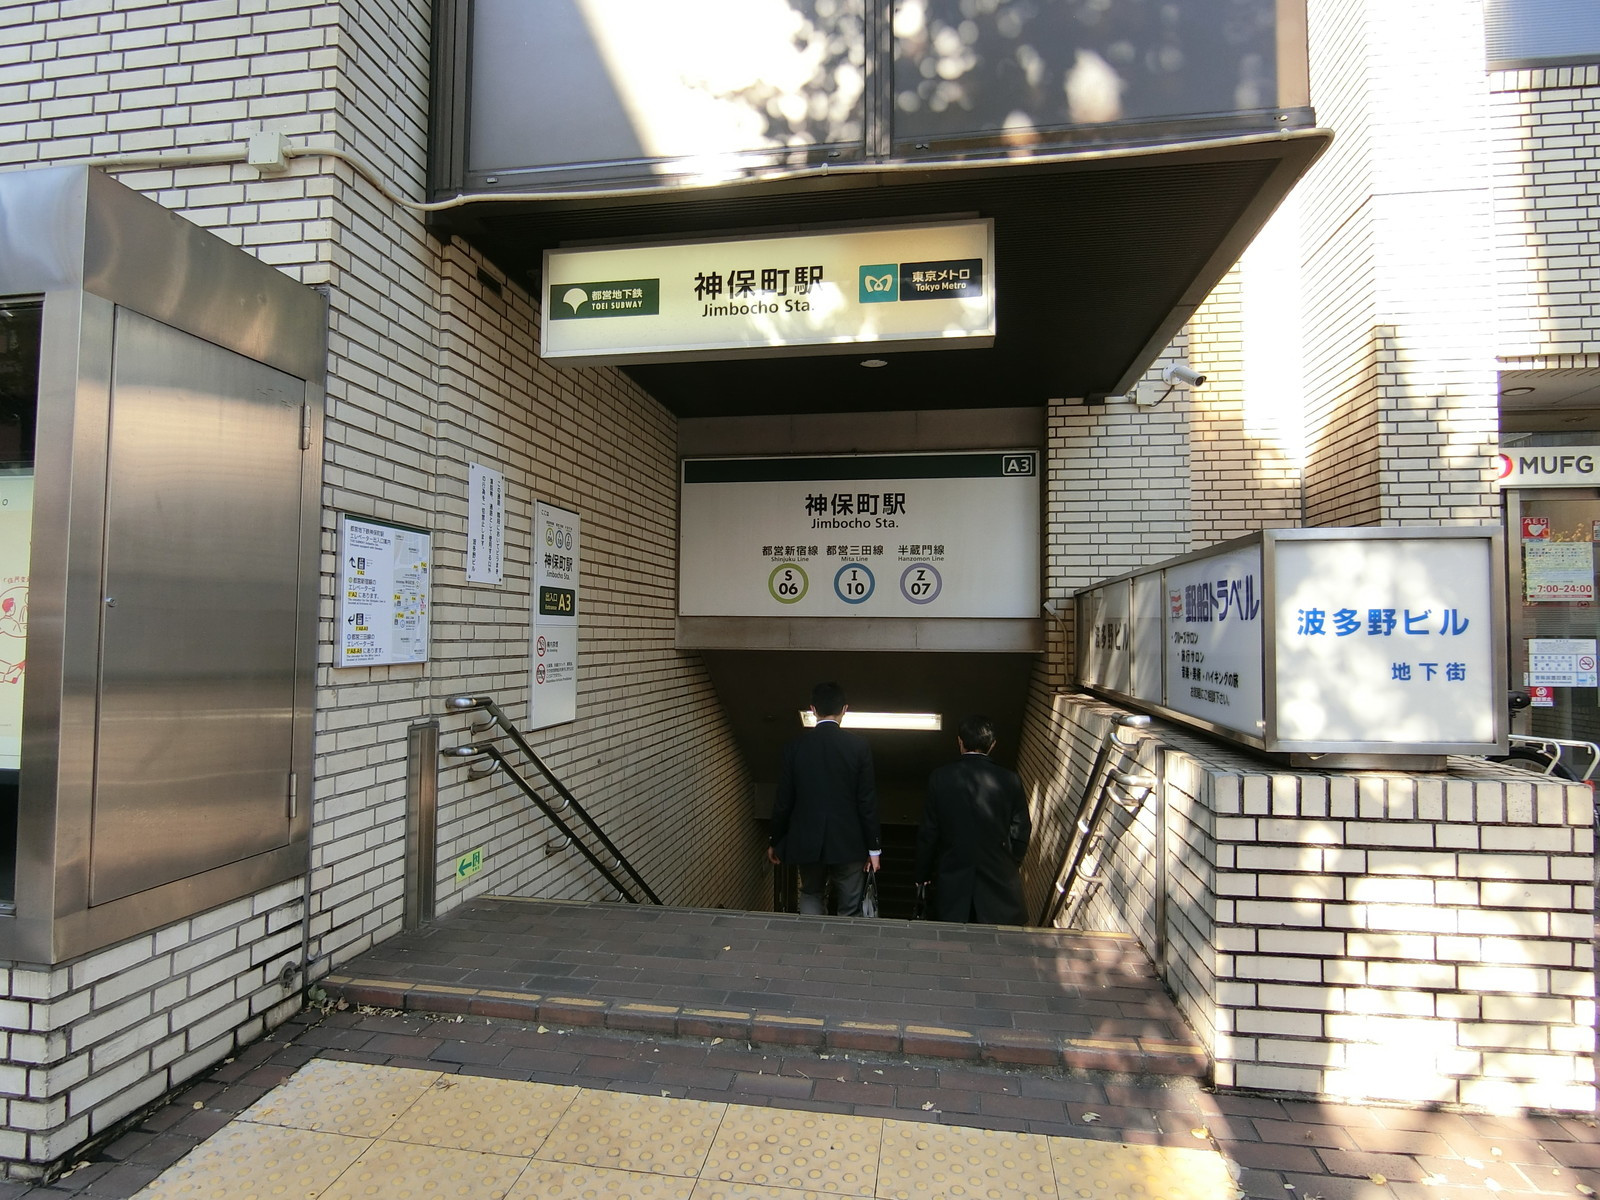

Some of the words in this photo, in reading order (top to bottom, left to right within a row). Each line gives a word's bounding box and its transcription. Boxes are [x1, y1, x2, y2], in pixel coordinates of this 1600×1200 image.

[912, 269, 970, 283] 東京メトロ
[694, 265, 823, 301] 神保町駅
[916, 283, 940, 292] Tokyo
[941, 281, 966, 290] Metro
[592, 288, 642, 301] 都営地下鉄
[611, 300, 643, 310] SUBWAY
[702, 300, 779, 317] Jimbocho
[785, 299, 815, 313] Sta.
[1007, 459, 1030, 472] A3
[1520, 455, 1594, 475] MUFG
[805, 493, 906, 516] 神保町駅
[811, 518, 871, 529] Jimbocho
[875, 517, 899, 529] Sta.
[762, 545, 818, 556] 都営新宿線
[826, 545, 884, 556] 都営三田線
[898, 545, 945, 556] 半蔵門線
[544, 552, 573, 572] 神保町駅
[785, 570, 793, 581] S
[851, 570, 858, 581] I
[917, 570, 926, 581] Z
[778, 583, 798, 595] 06
[846, 583, 865, 595] 10
[910, 583, 931, 595] 07
[545, 592, 558, 602] 出入口
[558, 593, 571, 612] A3
[1297, 608, 1470, 637] 波多野ビル
[1391, 662, 1467, 682] 地下街
